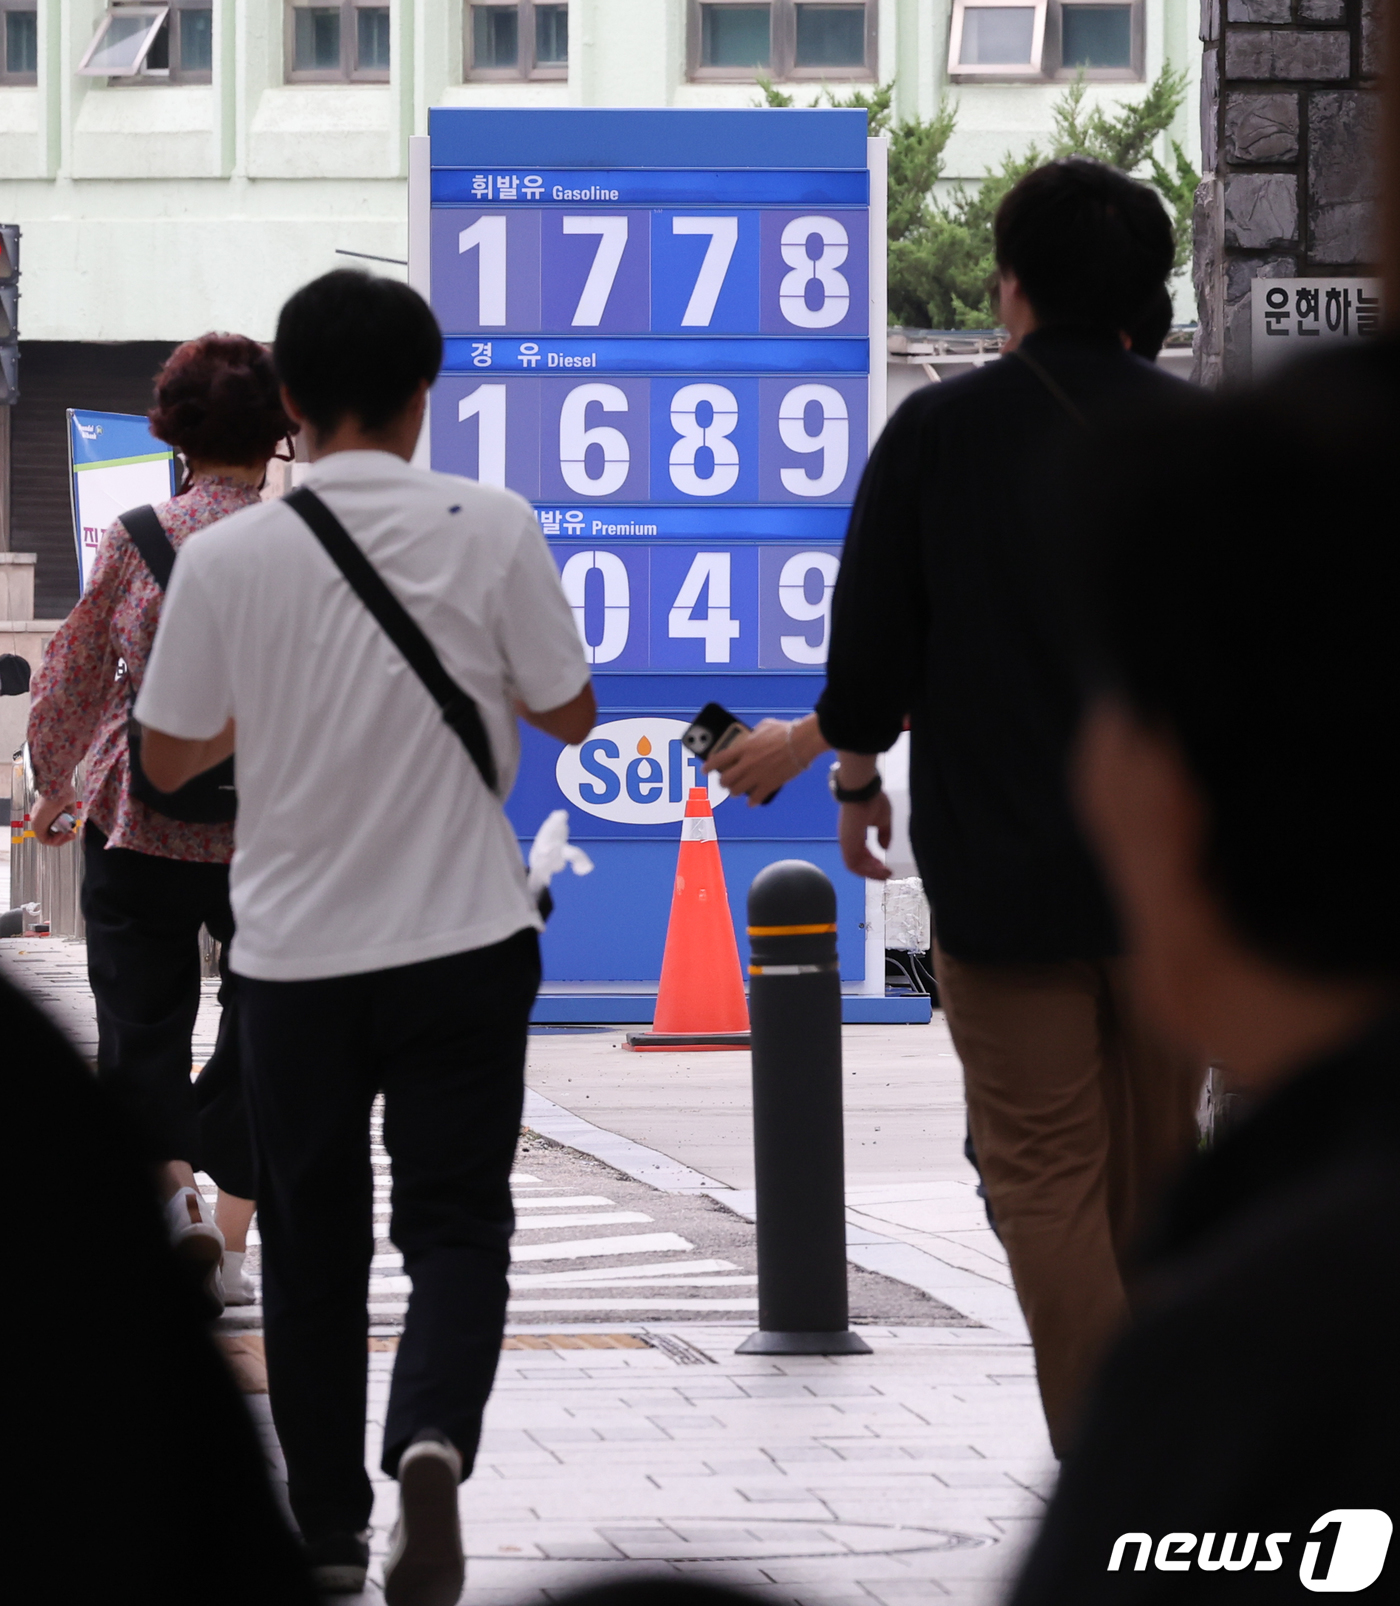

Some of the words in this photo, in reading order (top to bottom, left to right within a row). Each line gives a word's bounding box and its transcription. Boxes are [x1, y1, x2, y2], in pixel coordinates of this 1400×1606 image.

[471, 175, 545, 200] 휘발유
[552, 185, 619, 201] Gasoline
[459, 216, 850, 328] 1778
[547, 352, 596, 368] Diesel
[459, 383, 849, 496] 1689
[534, 510, 586, 535] 발유
[592, 520, 657, 536] Premium
[561, 551, 840, 664] 049
